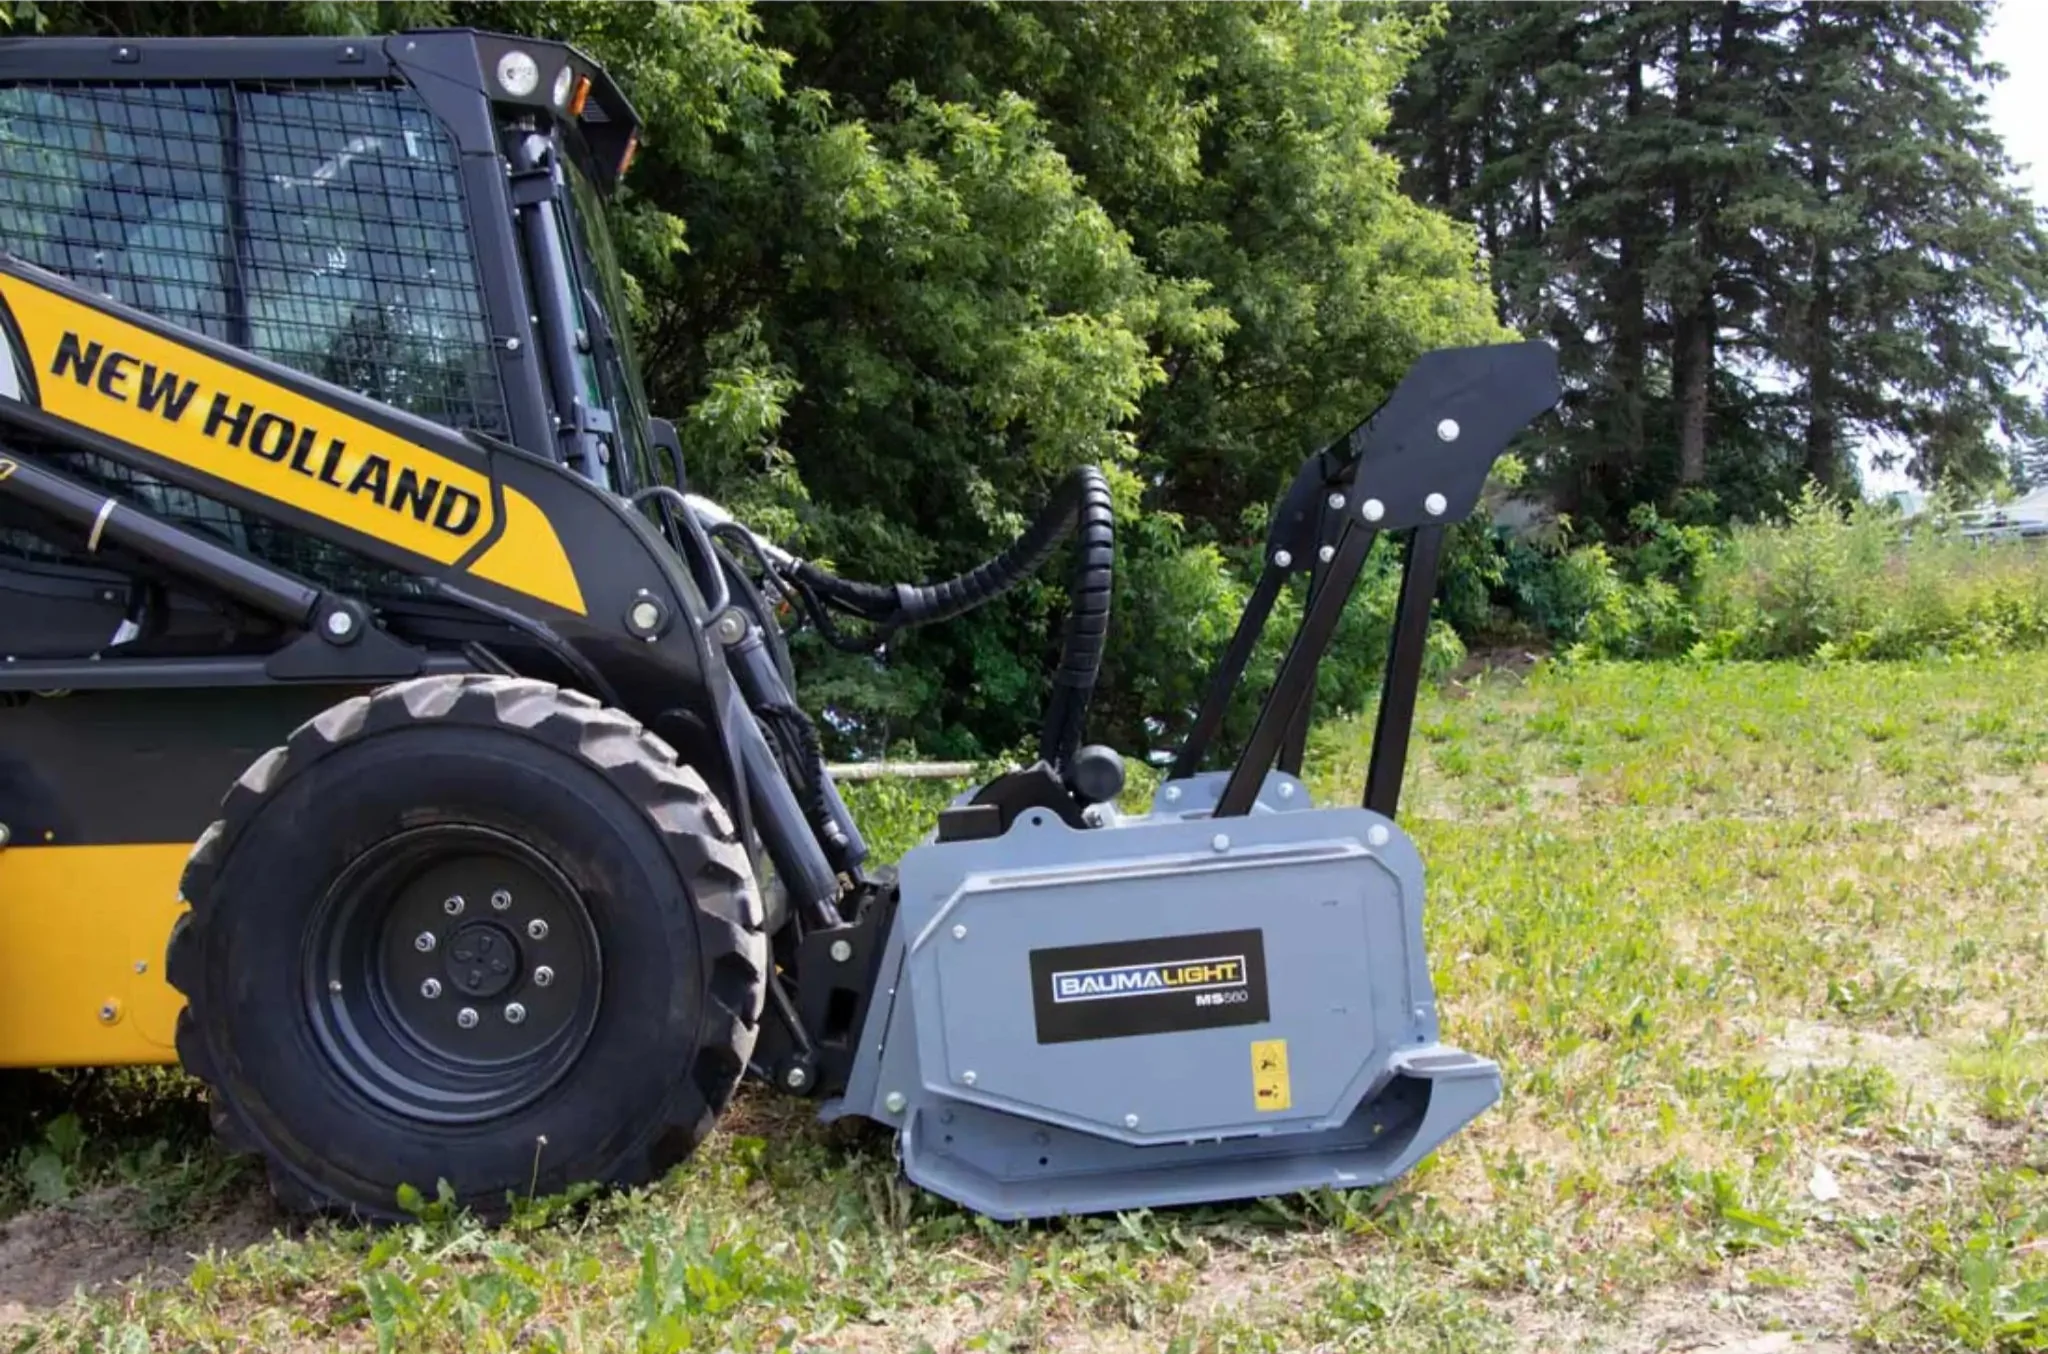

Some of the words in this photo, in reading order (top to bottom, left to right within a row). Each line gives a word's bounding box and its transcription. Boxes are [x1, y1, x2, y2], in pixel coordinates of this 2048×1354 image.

[51, 331, 199, 423] NEW
[202, 392, 482, 537] HOLLAND
[1060, 963, 1239, 996] BAUMALIGHT
